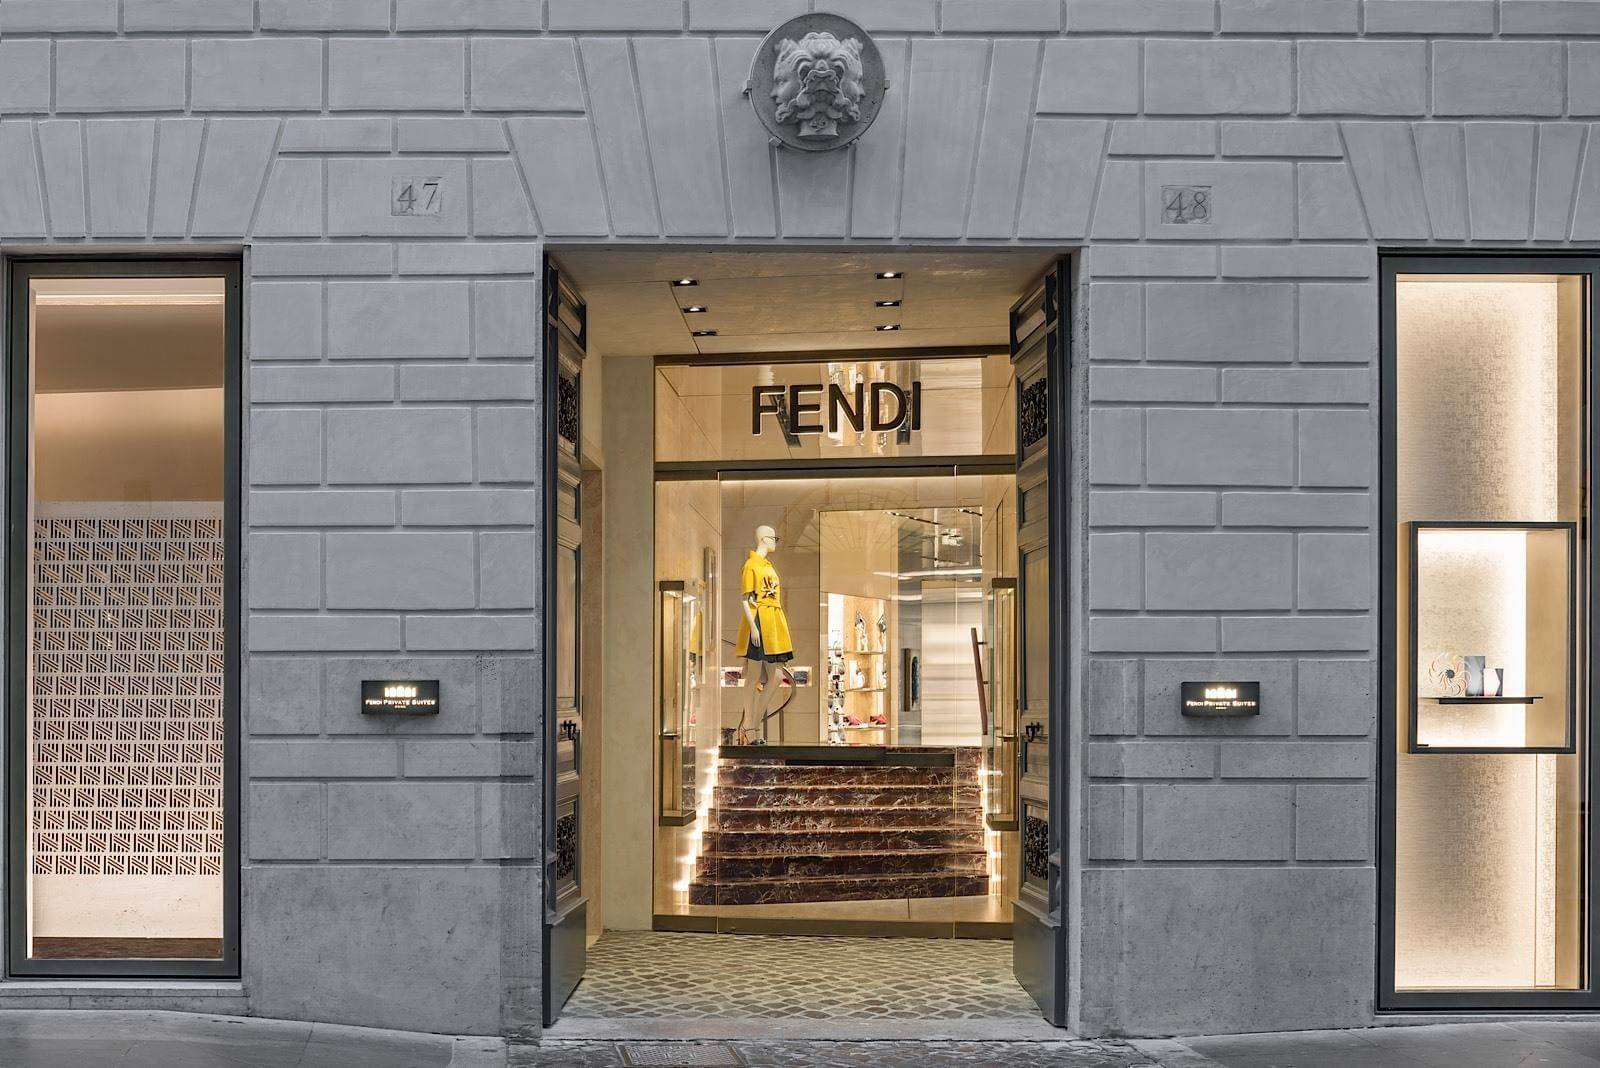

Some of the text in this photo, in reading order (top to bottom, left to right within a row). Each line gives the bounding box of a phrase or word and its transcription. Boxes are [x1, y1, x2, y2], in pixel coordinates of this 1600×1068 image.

[396, 182, 440, 211] 47
[1165, 191, 1208, 220] 48
[752, 381, 922, 435] FENDI
